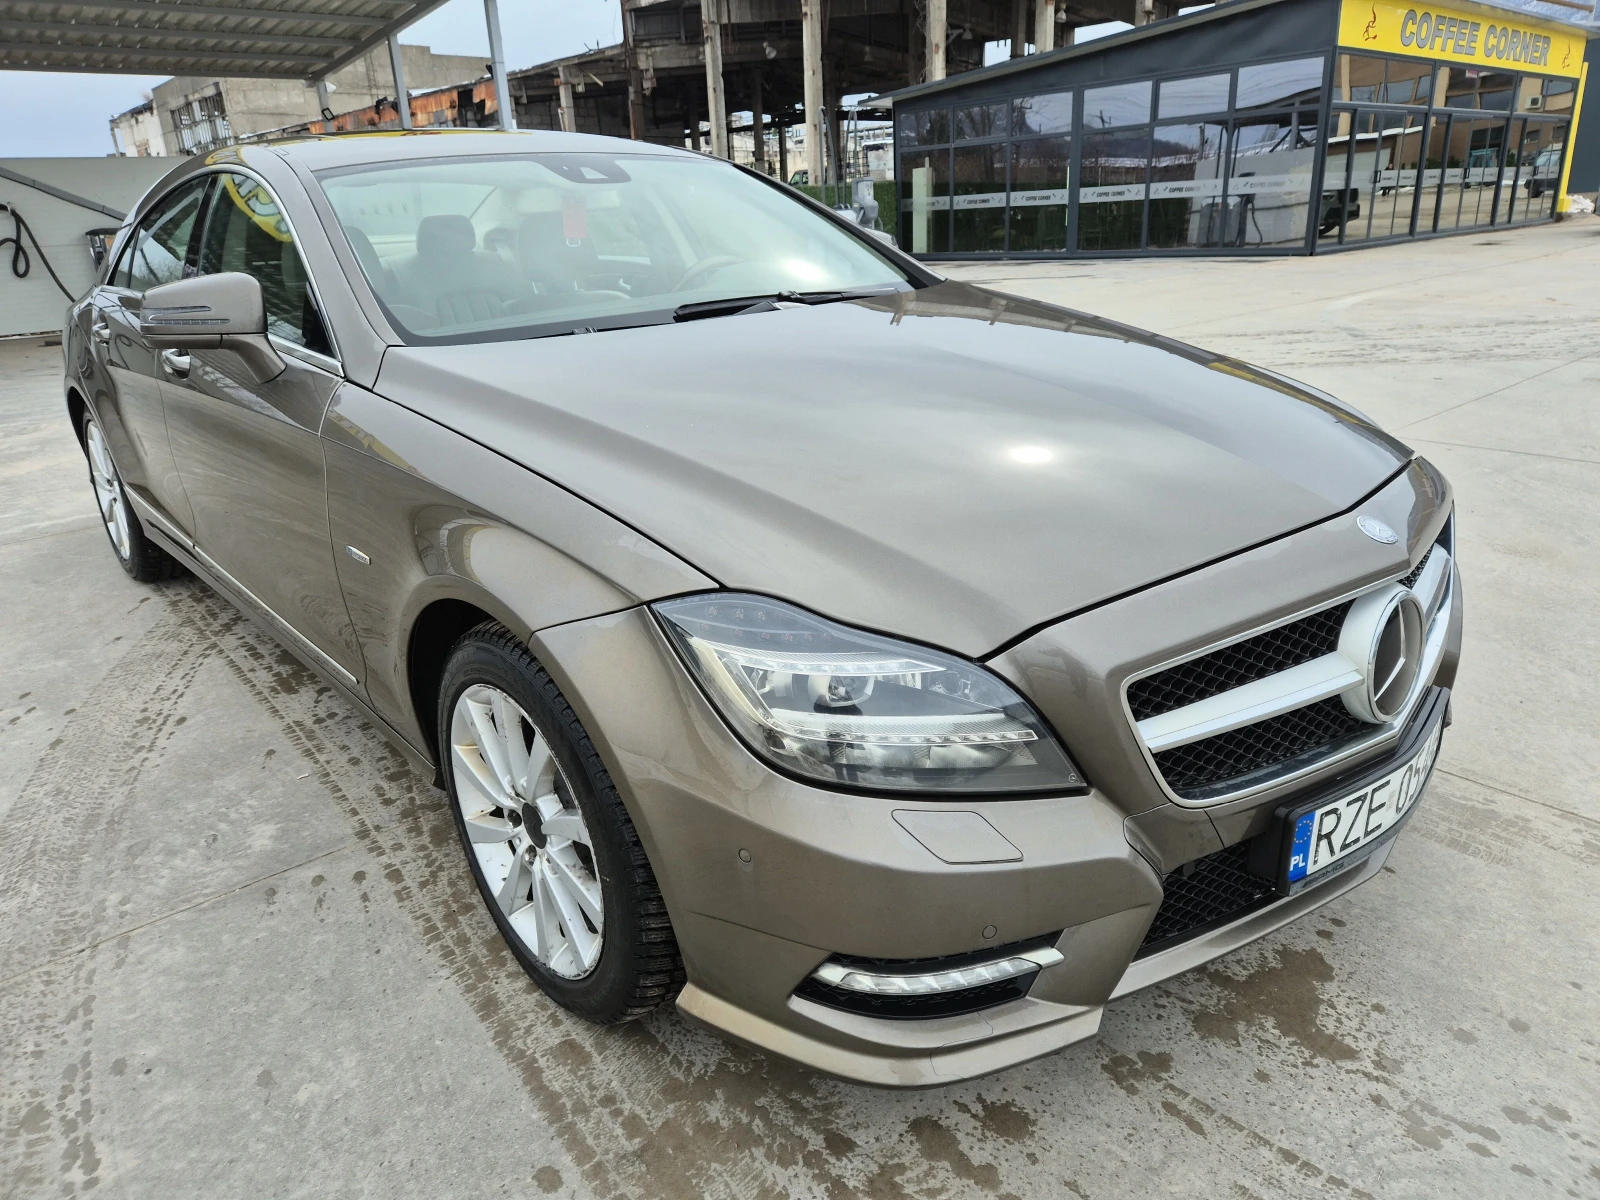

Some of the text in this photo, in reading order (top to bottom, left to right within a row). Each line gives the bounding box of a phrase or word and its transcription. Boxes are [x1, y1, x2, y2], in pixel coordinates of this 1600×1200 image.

[1400, 9, 1551, 66] COFFEE CORNER
[1313, 779, 1391, 866] RZE
[1290, 853, 1306, 871] PL
